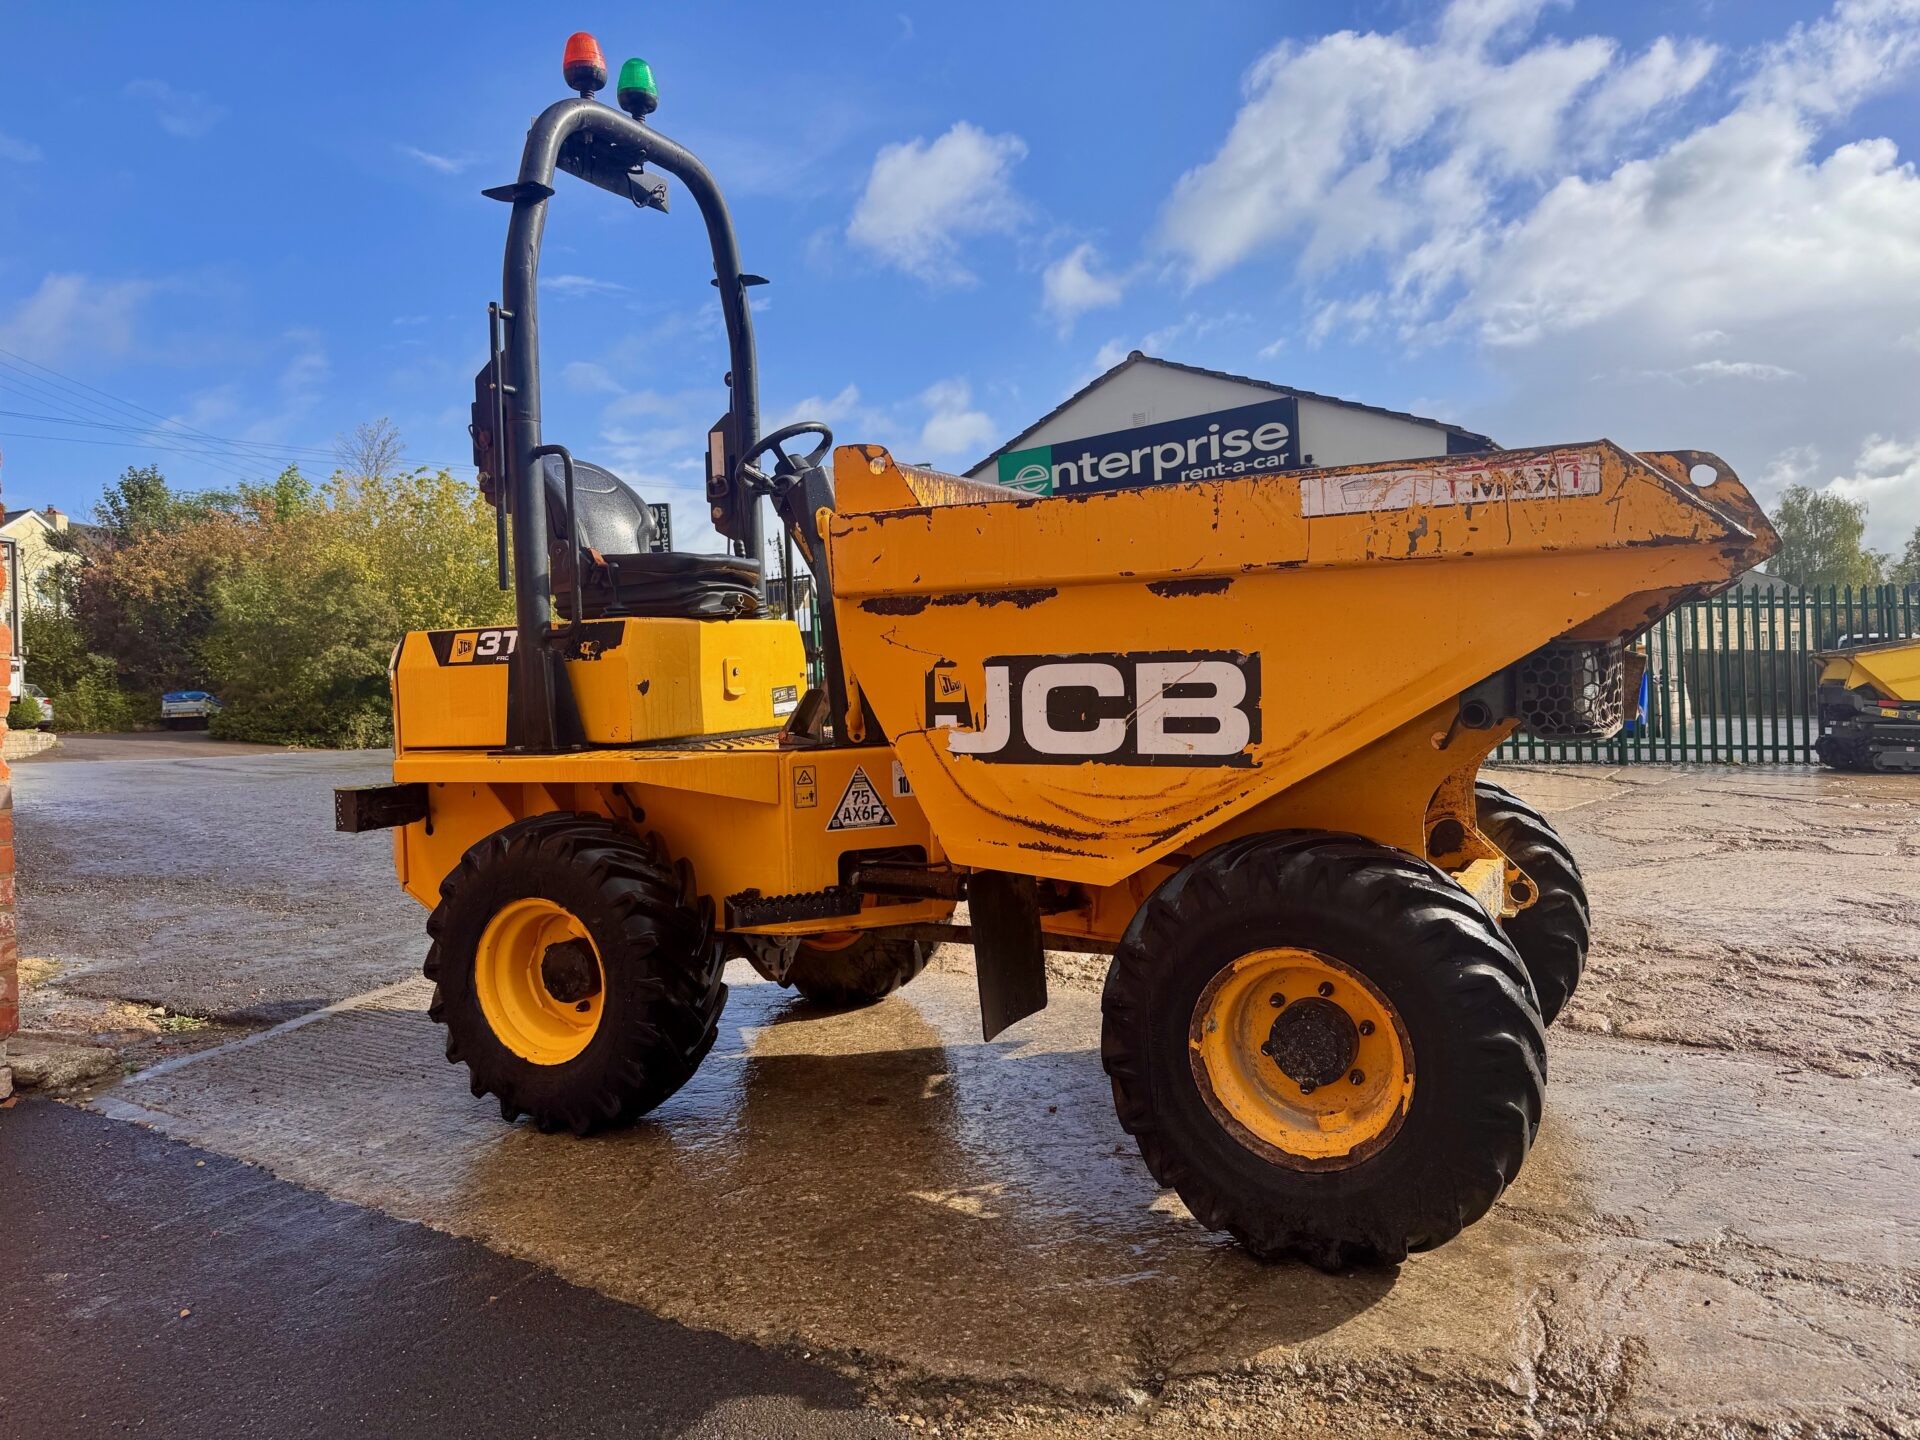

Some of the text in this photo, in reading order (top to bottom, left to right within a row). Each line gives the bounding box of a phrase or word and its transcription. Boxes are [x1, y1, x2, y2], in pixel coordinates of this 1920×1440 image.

[1000, 422, 1289, 493] enterprise
[1181, 453, 1289, 482] rent-a-car
[661, 506, 669, 552] nt-a-car
[458, 640, 472, 655] JCB
[946, 661, 1250, 756] JCB
[898, 776, 913, 794] 10
[852, 790, 870, 805] 75
[843, 805, 881, 823] AX6F
